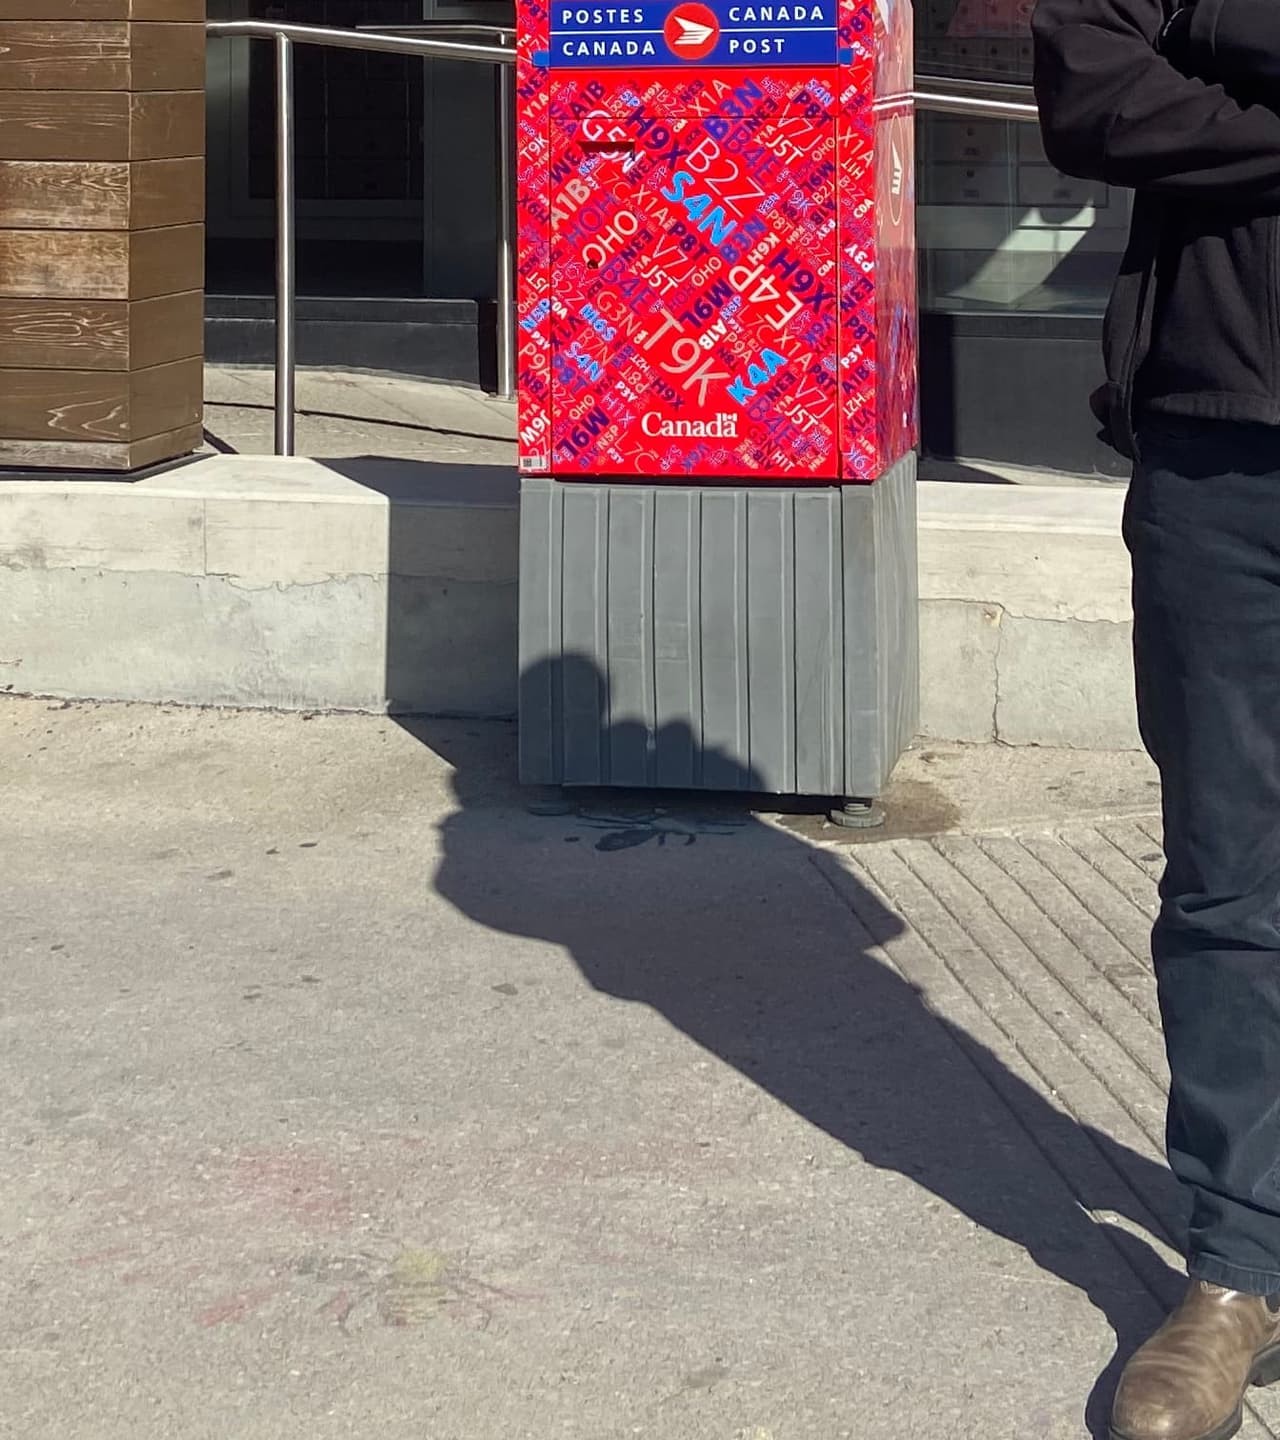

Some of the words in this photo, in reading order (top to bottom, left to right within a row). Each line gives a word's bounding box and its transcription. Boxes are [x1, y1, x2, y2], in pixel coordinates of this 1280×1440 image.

[562, 8, 644, 25] POSTES
[729, 6, 824, 22] CANADA
[562, 41, 656, 57] CANADA
[729, 38, 786, 54] POST
[521, 92, 549, 119] Y1A
[571, 80, 605, 119] A1B
[687, 79, 732, 117] X1A
[702, 78, 763, 141] B3N
[745, 97, 779, 131] E3N
[794, 89, 833, 127] P8T
[625, 105, 689, 170] H9X
[753, 124, 777, 145] Y1A
[777, 103, 822, 151] V7J
[520, 132, 549, 162] T9K
[723, 127, 782, 185] B4E
[766, 134, 805, 165] J5T
[838, 126, 874, 168] X1A
[685, 136, 765, 218] B2Z
[841, 158, 865, 180] H1T
[551, 178, 591, 231] A1B
[631, 184, 669, 227] X1A
[660, 170, 738, 247] S4N
[766, 209, 794, 234] P8T
[621, 228, 654, 261] E3N
[668, 221, 710, 260] P8T
[720, 215, 767, 264] B3N
[747, 233, 780, 265] K6H
[628, 255, 652, 275] Y1A
[653, 234, 697, 282] V7J
[845, 244, 875, 272] P3Y
[526, 272, 549, 293] J5T
[600, 256, 655, 315] B4E
[641, 265, 679, 296] J5T
[729, 264, 804, 329] E4P
[770, 248, 836, 313] H9X
[840, 277, 874, 311] E3N
[596, 290, 643, 337] G3N
[679, 278, 734, 329] M9L
[698, 319, 727, 349] A1B
[842, 316, 876, 344] P8T
[564, 341, 605, 382] S4N
[643, 306, 732, 408] T9K
[723, 332, 753, 364] P9A
[773, 328, 813, 372] X1A
[841, 343, 864, 368] P3Y
[615, 381, 638, 402] P3Y
[726, 347, 788, 406] K4A
[766, 372, 796, 400] E3N
[809, 364, 837, 390] P8T
[841, 365, 869, 394] A1B
[774, 395, 794, 413] Y1A
[795, 375, 835, 419] V7J
[842, 393, 866, 420] H2T
[521, 410, 551, 446] J6W
[556, 407, 610, 458] M9L
[641, 411, 738, 438] Canada
[748, 397, 800, 446] B4E
[784, 404, 819, 432] J5T
[772, 450, 795, 472] H1T
